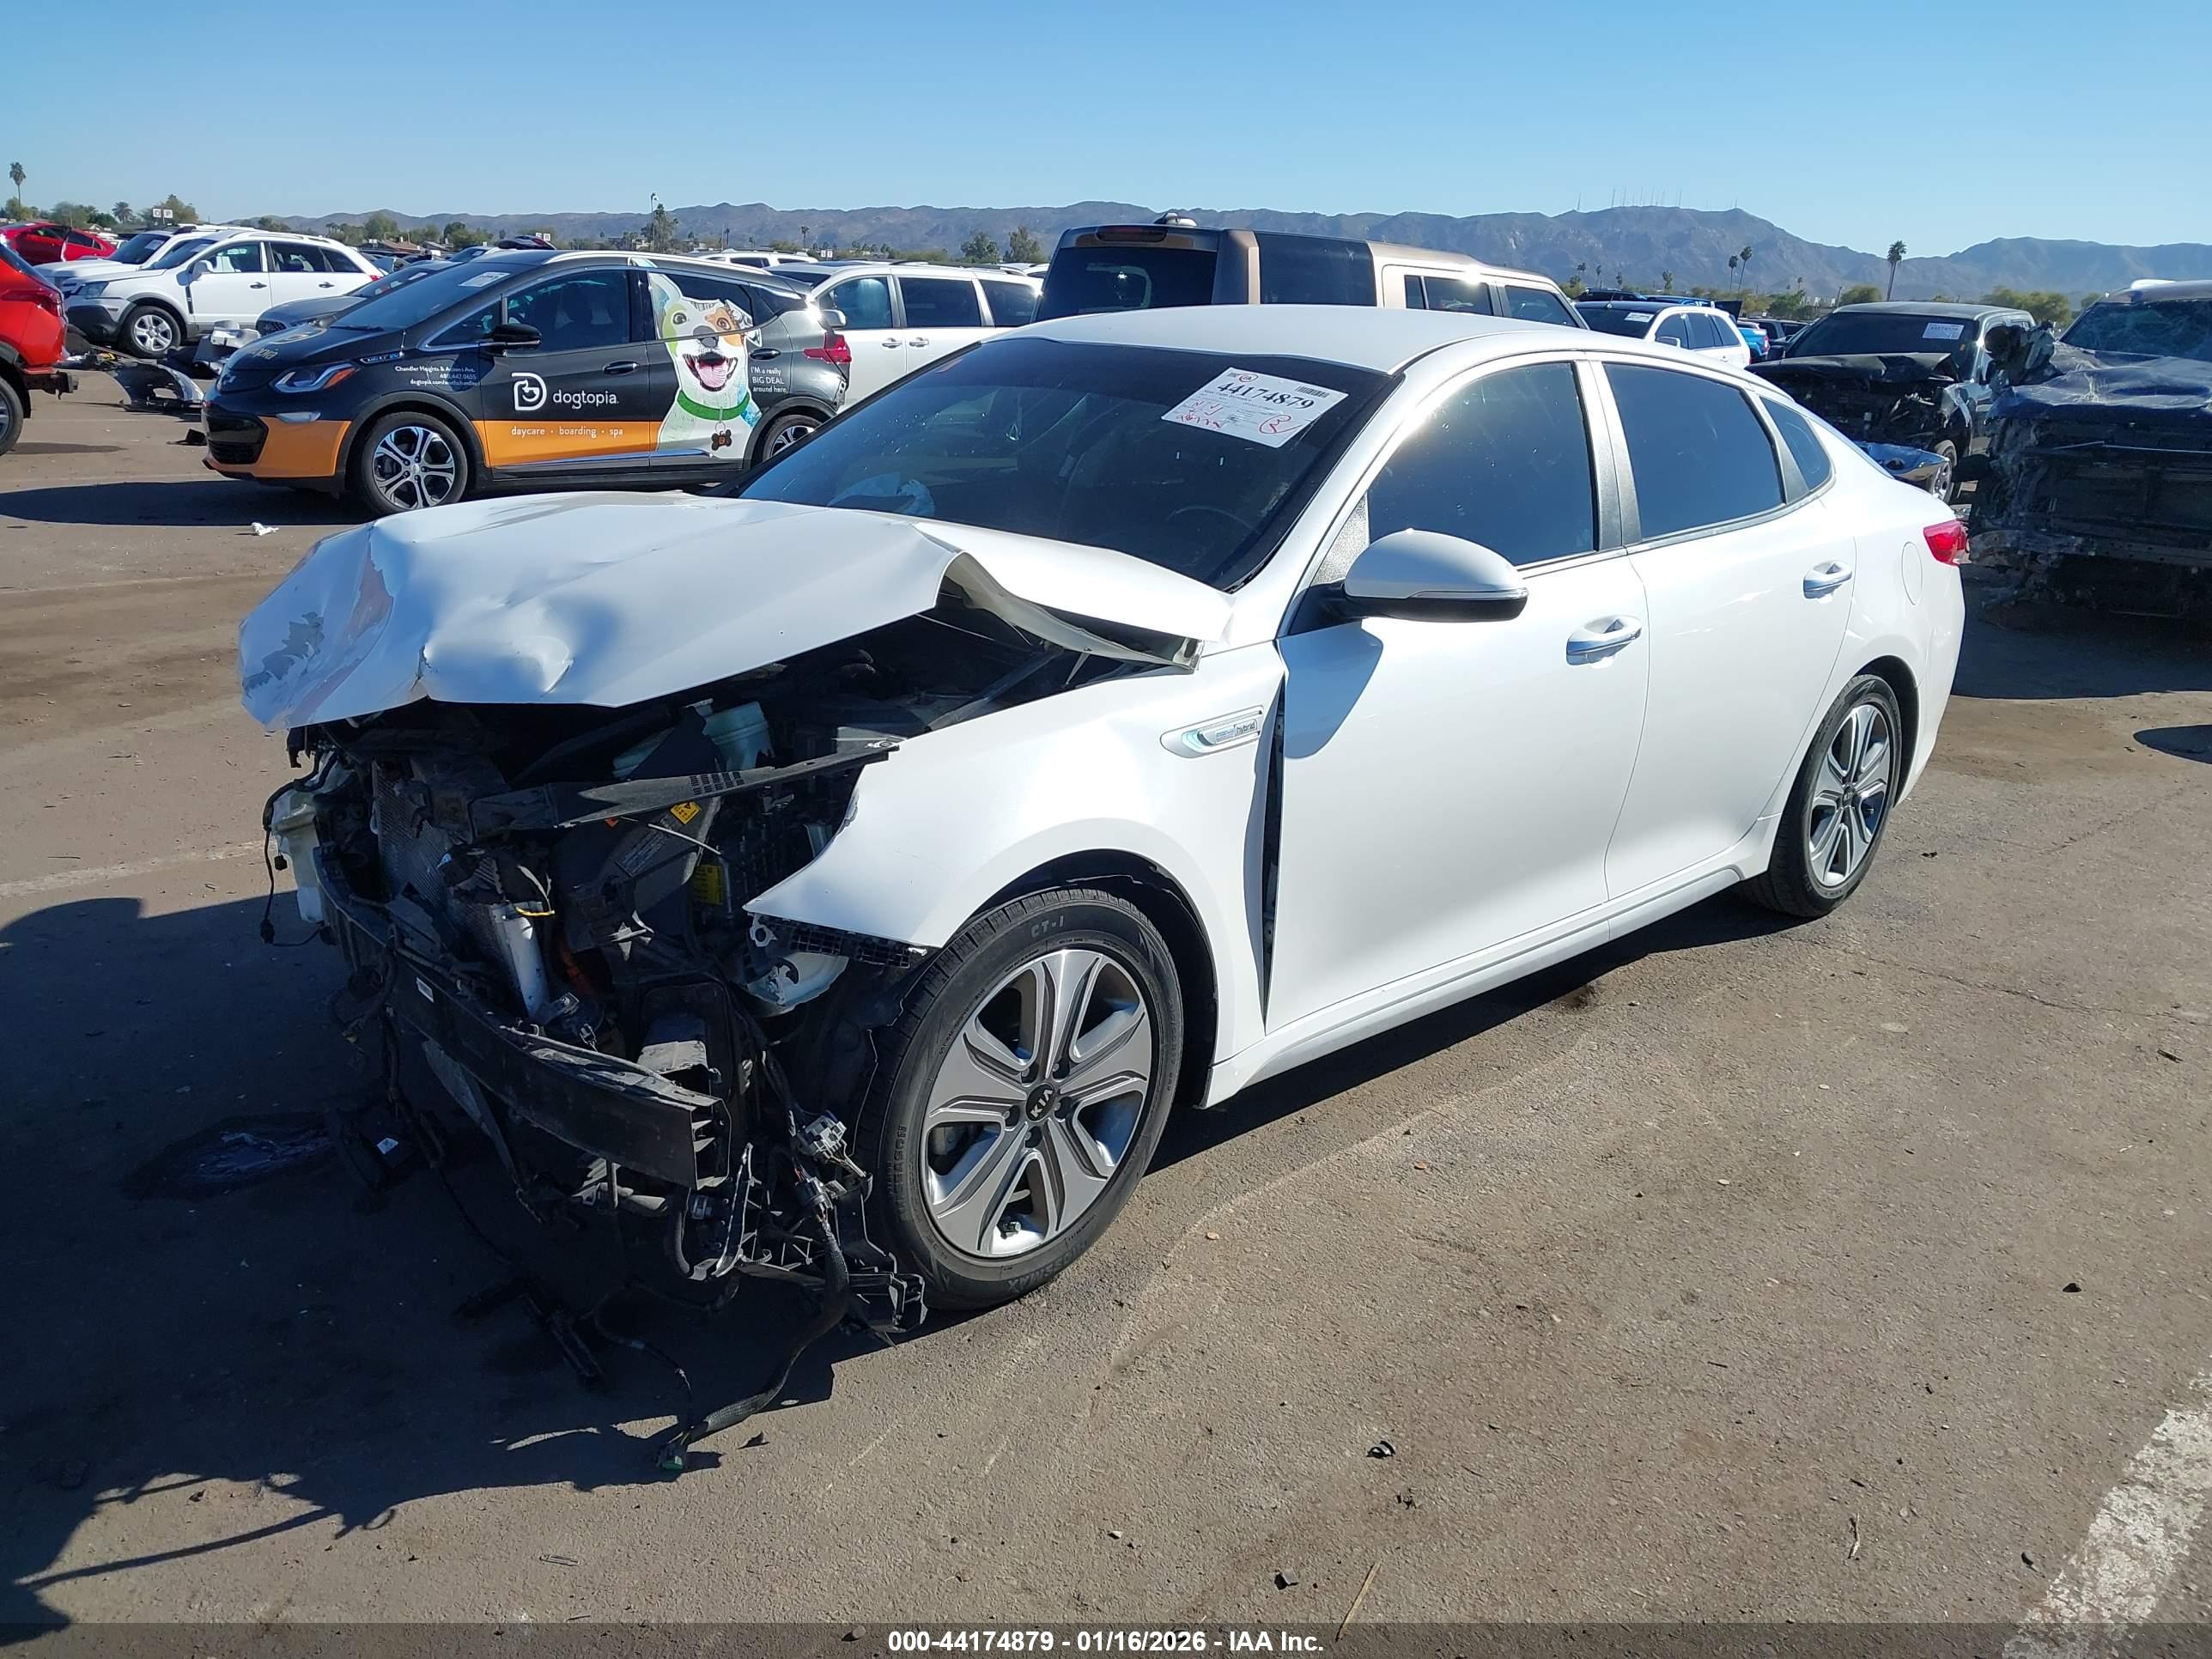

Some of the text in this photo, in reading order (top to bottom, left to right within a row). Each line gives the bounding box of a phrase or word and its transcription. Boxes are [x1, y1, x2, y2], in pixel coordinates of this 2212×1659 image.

[1217, 382, 1315, 410] 44174879
[511, 426, 623, 439] daycare boarding spa
[1237, 720, 1255, 735] hybrid
[1030, 1089, 1053, 1118] KIA
